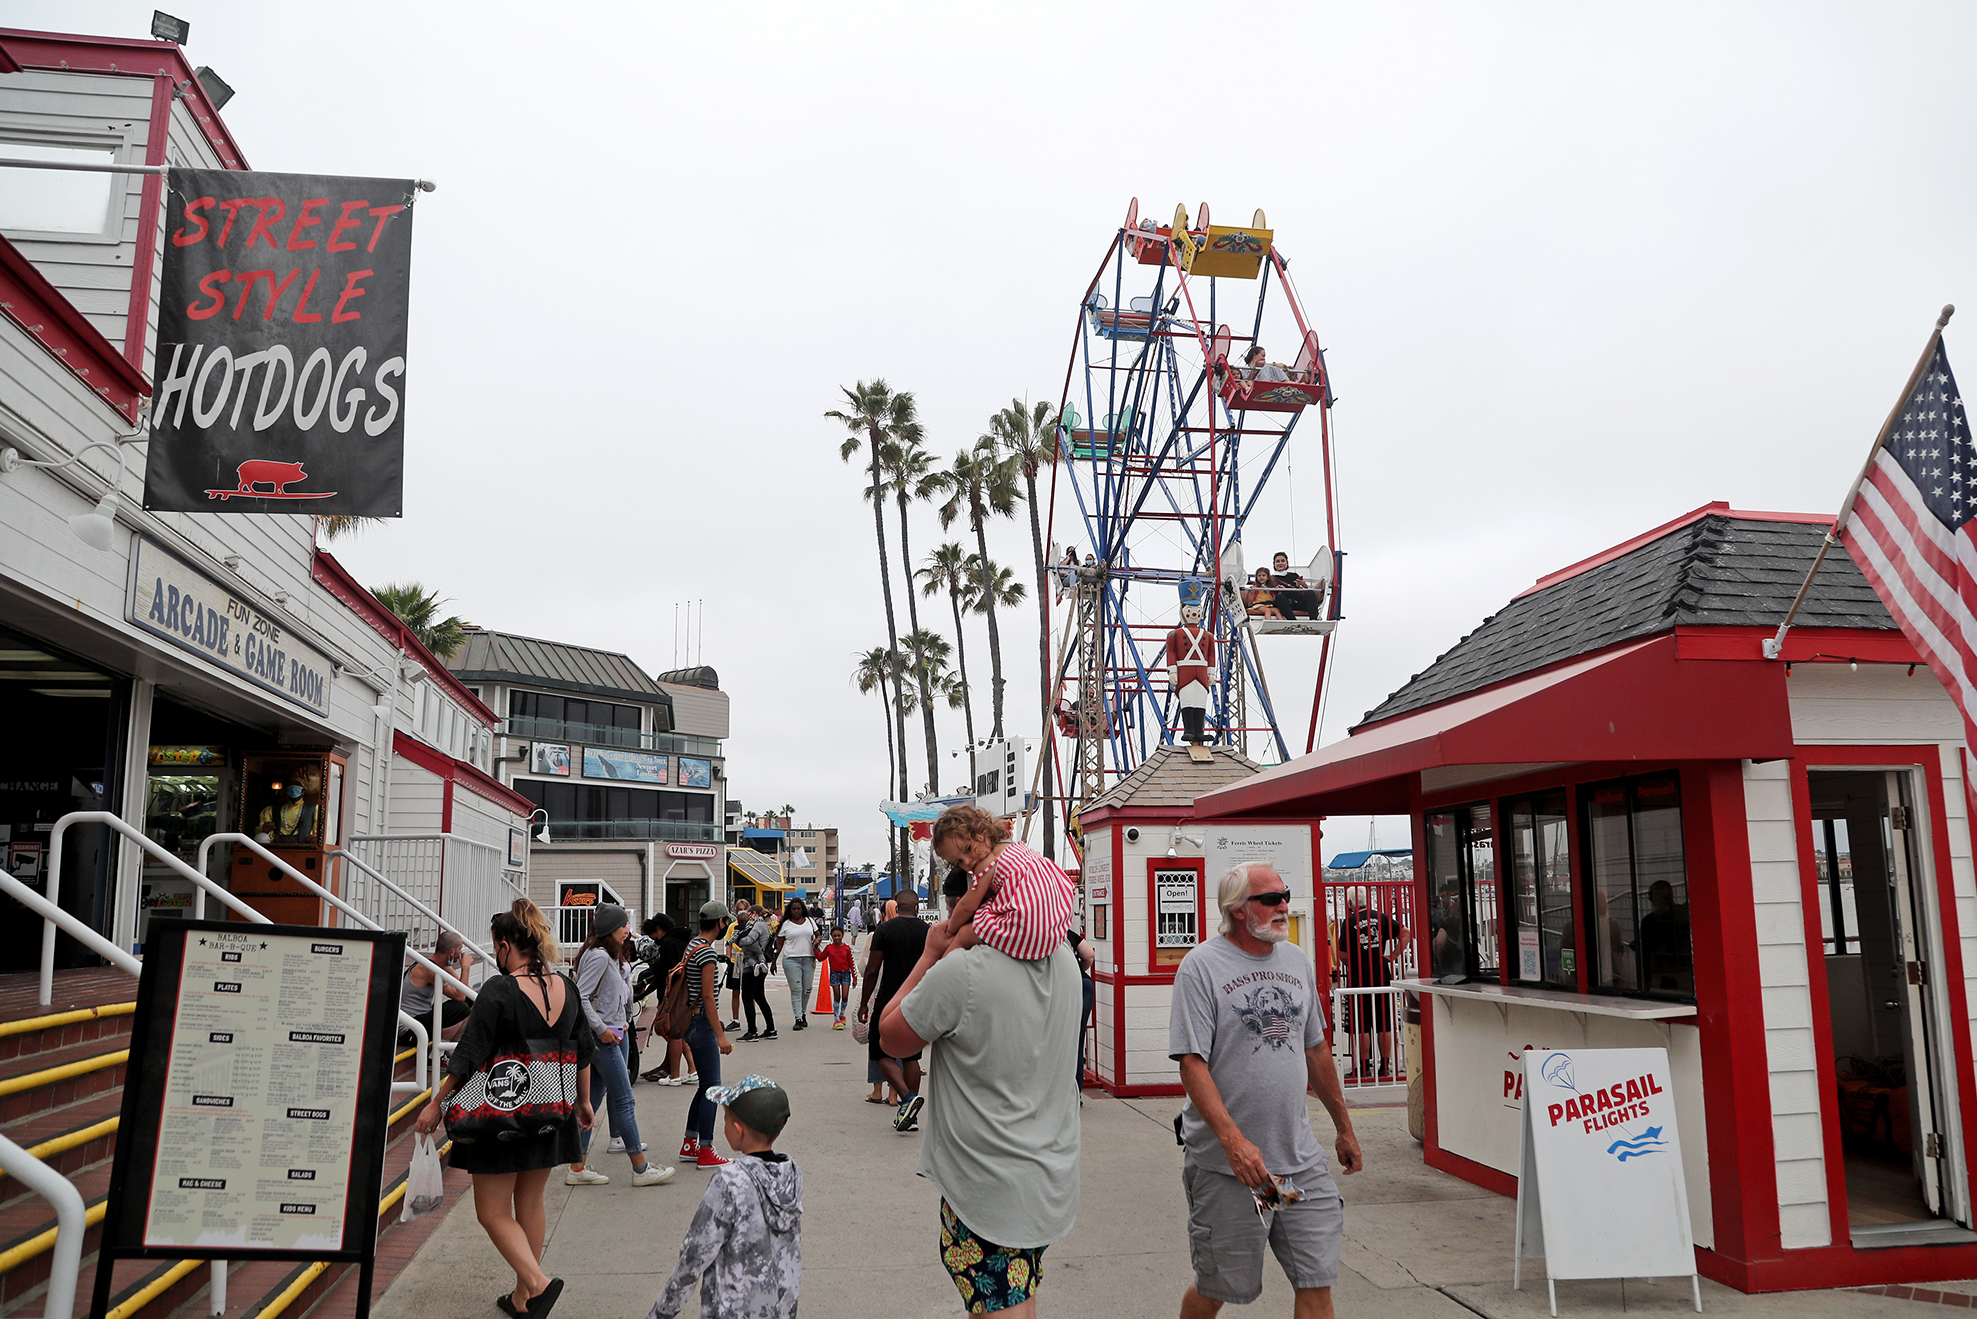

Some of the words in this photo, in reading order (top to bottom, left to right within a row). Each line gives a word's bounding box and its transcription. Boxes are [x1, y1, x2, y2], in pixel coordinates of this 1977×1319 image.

[173, 196, 404, 253] STREET
[186, 268, 374, 324] STYLE
[151, 344, 405, 437] HOTDOGS
[227, 598, 250, 625] FUN
[253, 615, 280, 644] ZONE
[150, 577, 230, 658] ARCADE
[234, 633, 241, 655] &
[245, 632, 285, 688] GAME
[290, 658, 324, 707] ROOM
[671, 846, 694, 854] AZAR'S
[1166, 890, 1188, 898] Open!
[218, 934, 248, 943] BALBOA
[208, 942, 256, 952] BAR-B-QUE
[314, 945, 340, 954] BURGERS
[224, 953, 238, 961] RIBS
[1222, 974, 1250, 994] BASS
[1251, 971, 1274, 982] PRO
[1276, 972, 1303, 990] SHOPS
[212, 1034, 230, 1042] SIDES
[292, 1032, 312, 1041] BALBOA
[313, 1034, 342, 1042] FAVORITES
[488, 1077, 510, 1090] VANS
[196, 1097, 230, 1106] SANDWICHES
[1548, 1073, 1663, 1127] PARASAIL
[290, 1110, 312, 1118] STREET
[312, 1110, 327, 1118] DOGS
[1583, 1101, 1650, 1134] FLIGHTS
[200, 1180, 223, 1188] CHEESE
